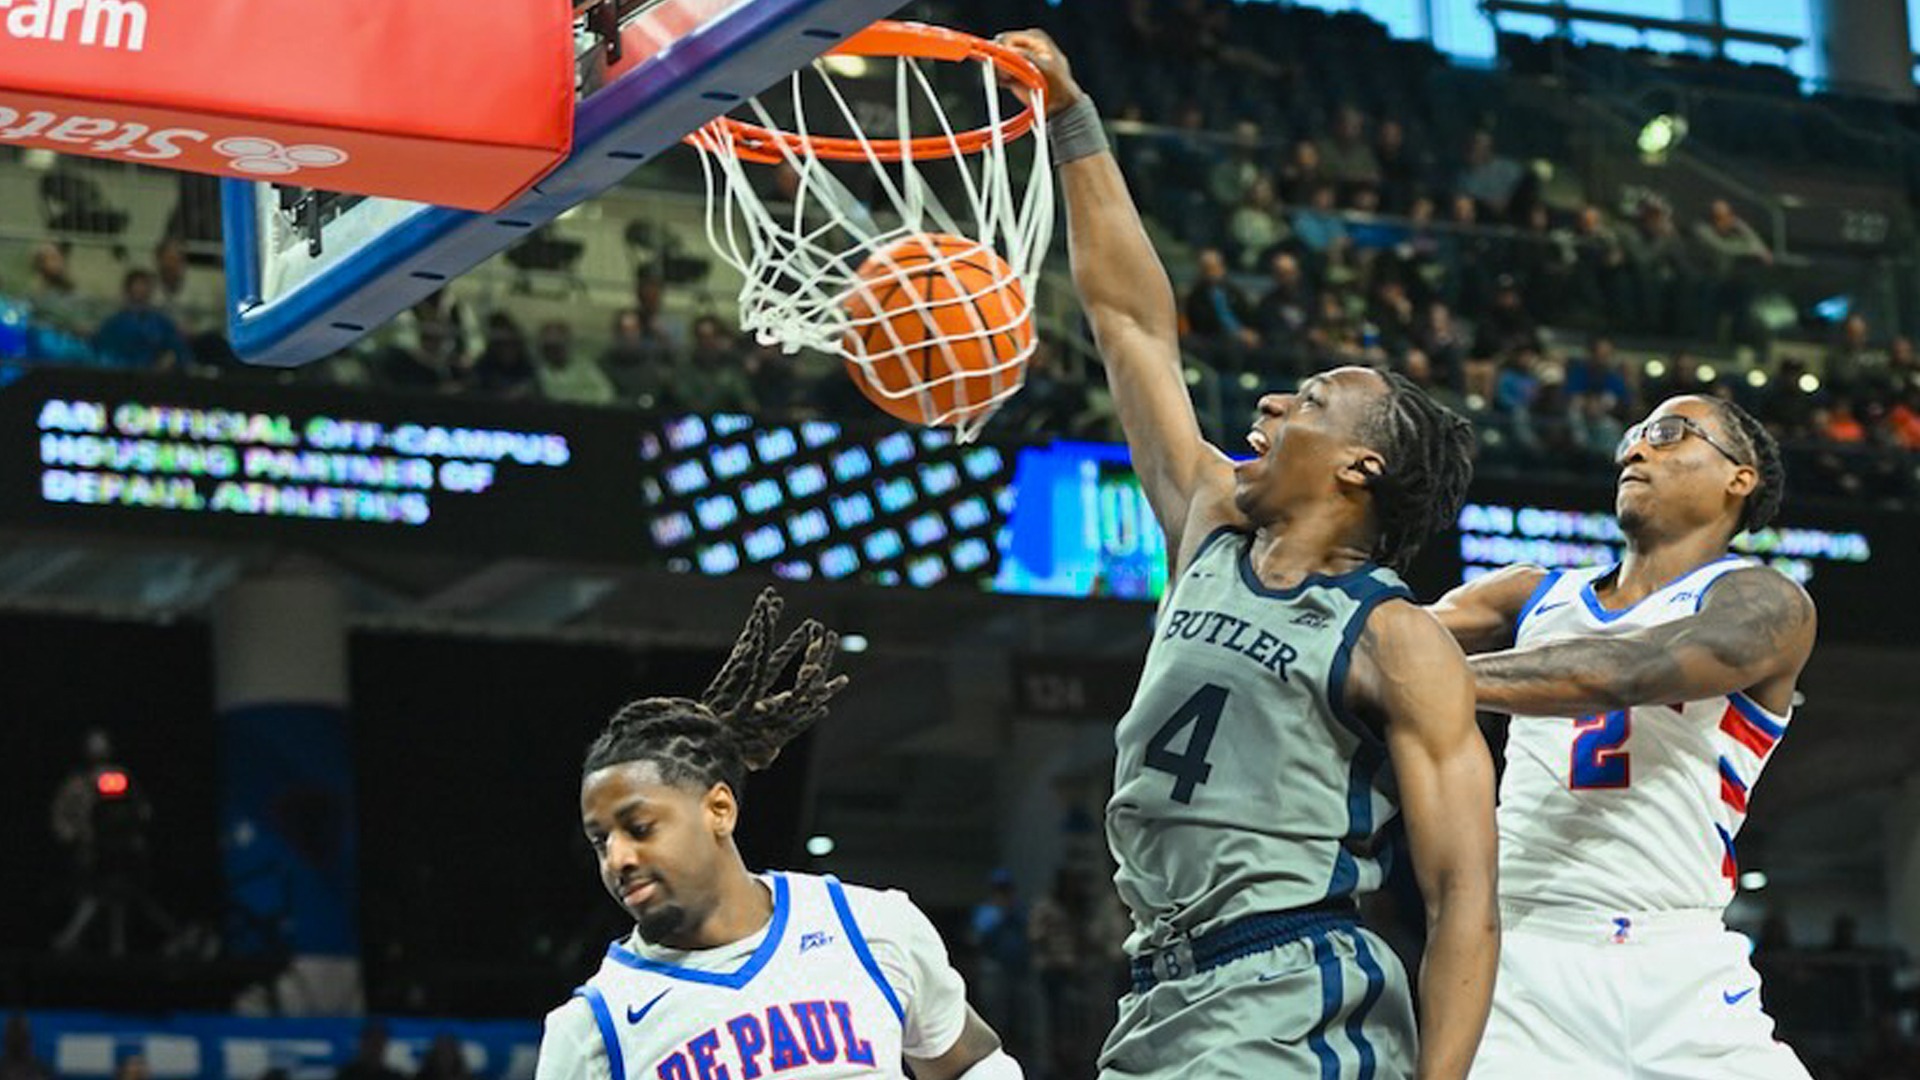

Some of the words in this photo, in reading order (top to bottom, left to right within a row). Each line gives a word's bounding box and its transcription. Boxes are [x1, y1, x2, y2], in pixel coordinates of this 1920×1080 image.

[0, 0, 148, 51] arm
[38, 399, 106, 433] AN
[113, 402, 299, 446] OFFICIAL
[304, 415, 570, 467] OFF-CAMPUS
[40, 432, 237, 478] HOUSING
[244, 446, 434, 490] PARTNER
[438, 458, 495, 494] OF
[1162, 609, 1298, 682] BUTLER
[1144, 682, 1231, 805] 4
[1569, 704, 1631, 790] 2
[1163, 951, 1182, 977] B
[726, 999, 877, 1080] PAUL
